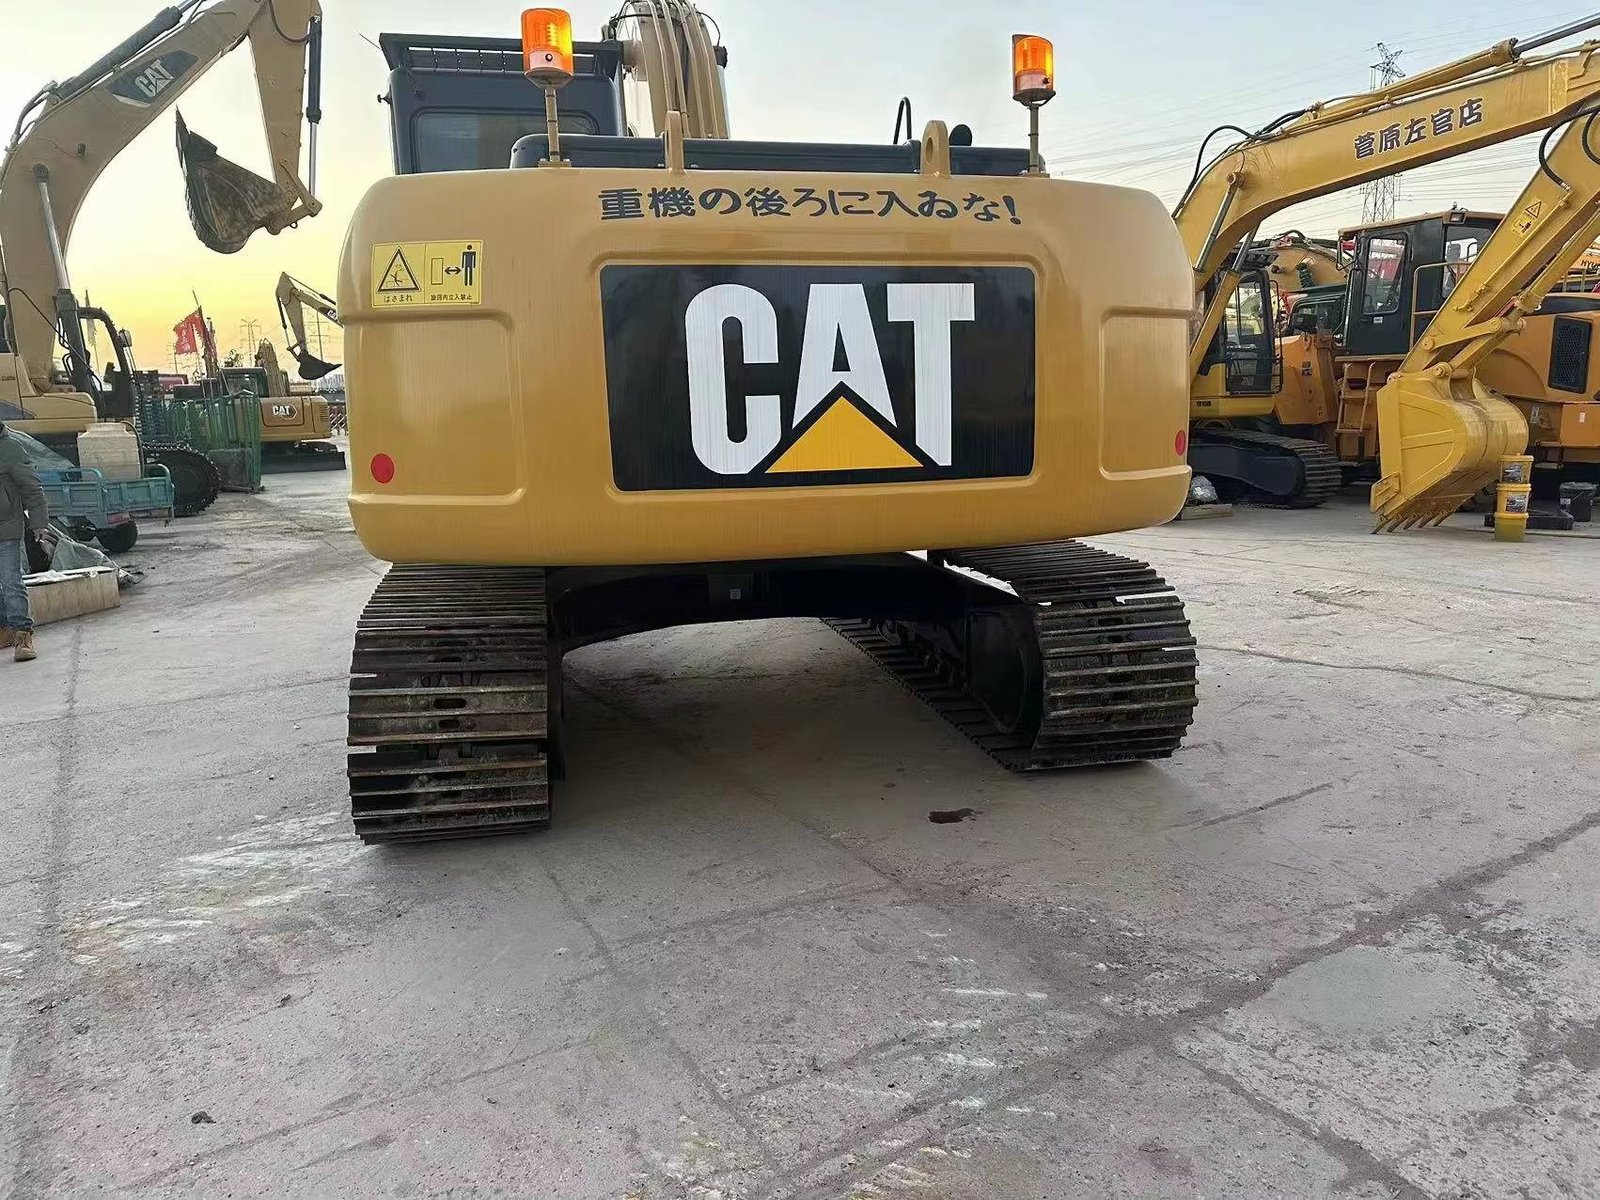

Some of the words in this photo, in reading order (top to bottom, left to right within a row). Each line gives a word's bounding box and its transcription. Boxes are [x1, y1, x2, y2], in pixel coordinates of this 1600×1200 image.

[134, 58, 174, 98] CAT
[1354, 97, 1484, 160] 菅原左官店
[383, 293, 413, 303] はさまれ
[685, 283, 976, 475] CAT
[272, 405, 291, 416] CAT
